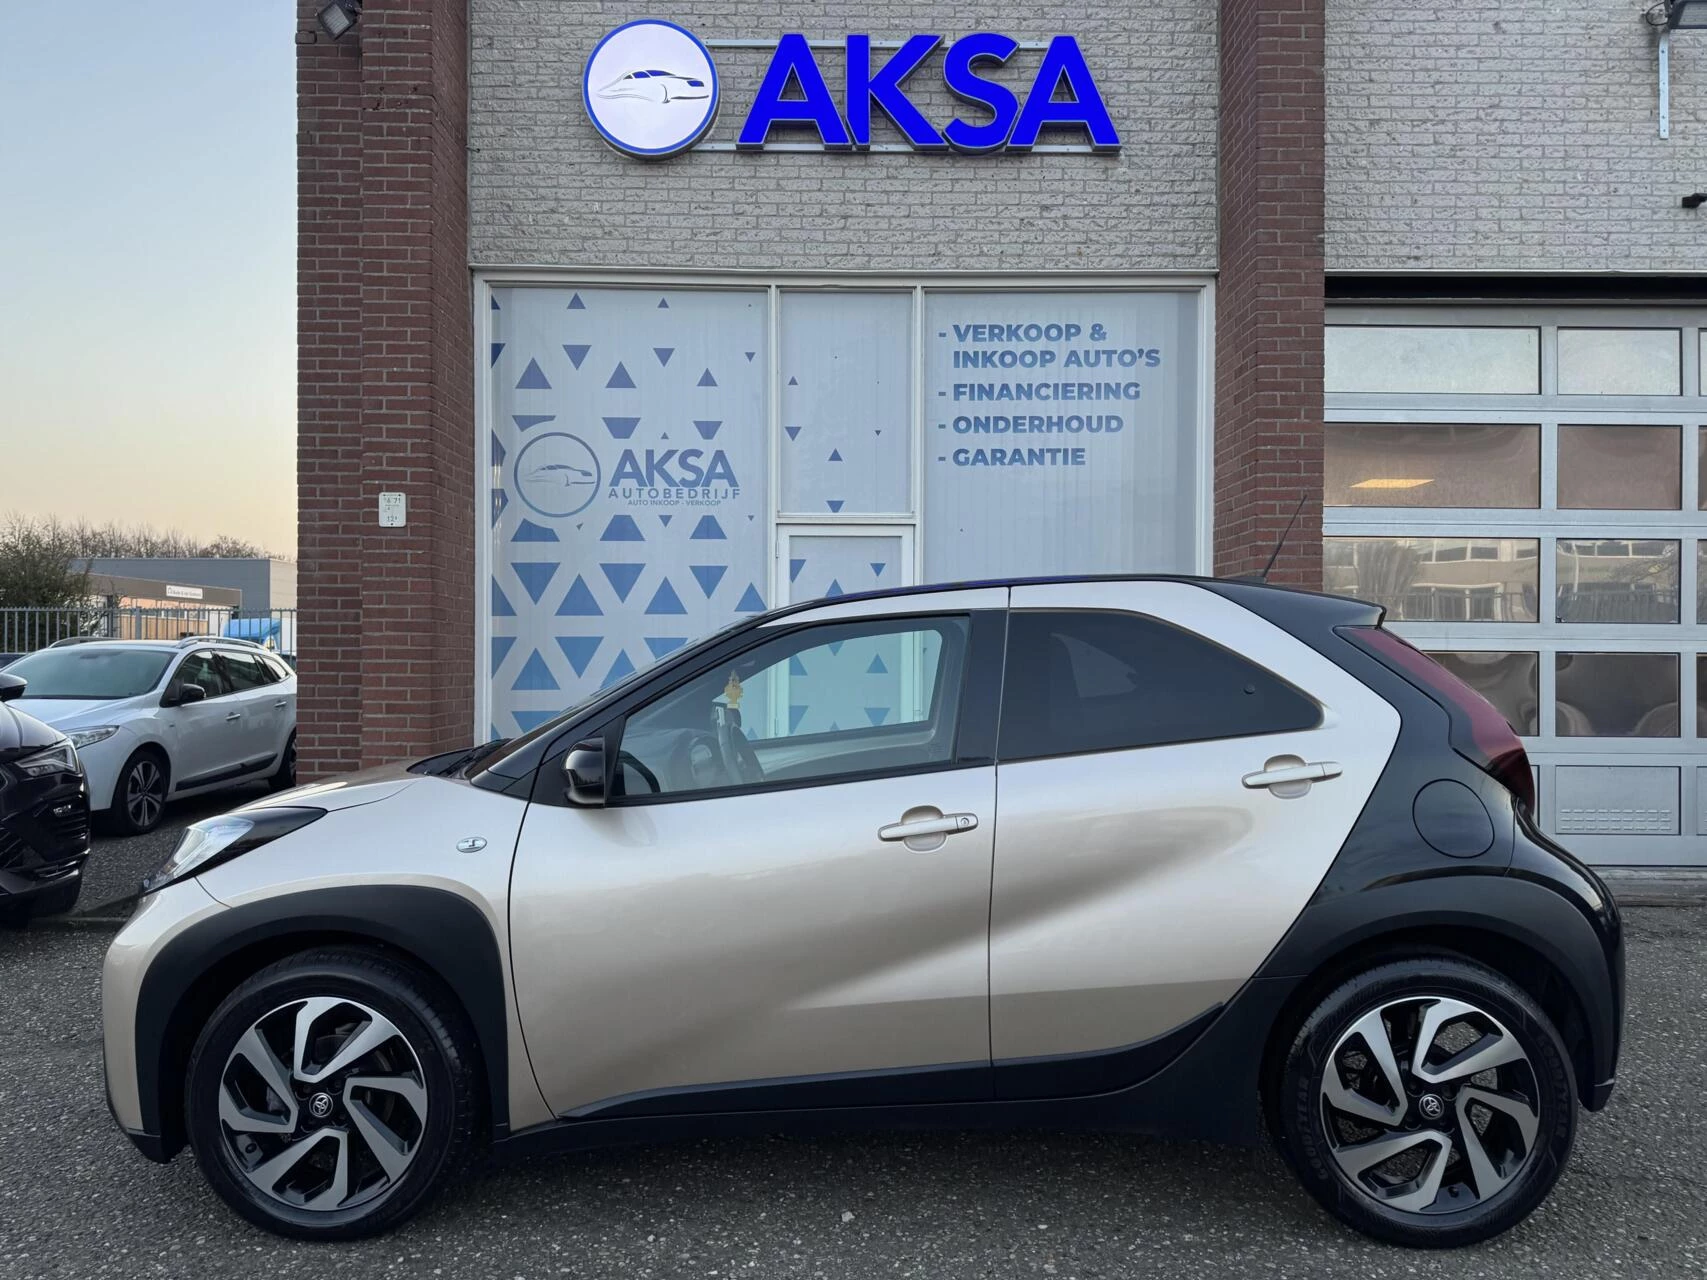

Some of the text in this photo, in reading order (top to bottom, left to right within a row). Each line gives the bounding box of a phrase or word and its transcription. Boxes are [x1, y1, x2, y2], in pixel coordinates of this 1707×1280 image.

[735, 32, 1121, 154] AKSA
[952, 324, 1082, 342] VERKOOP
[1089, 323, 1107, 341] &
[953, 348, 1161, 368] INKOOP AUTO'S
[953, 382, 1141, 400] FINANCIERING
[952, 415, 1124, 433] ONDERHOUD
[952, 448, 1086, 466] GARANTIE
[609, 449, 739, 488] AKSA
[608, 488, 741, 500] AUTOBEDRIJF
[1296, 1076, 1329, 1179] GOODYEAR
